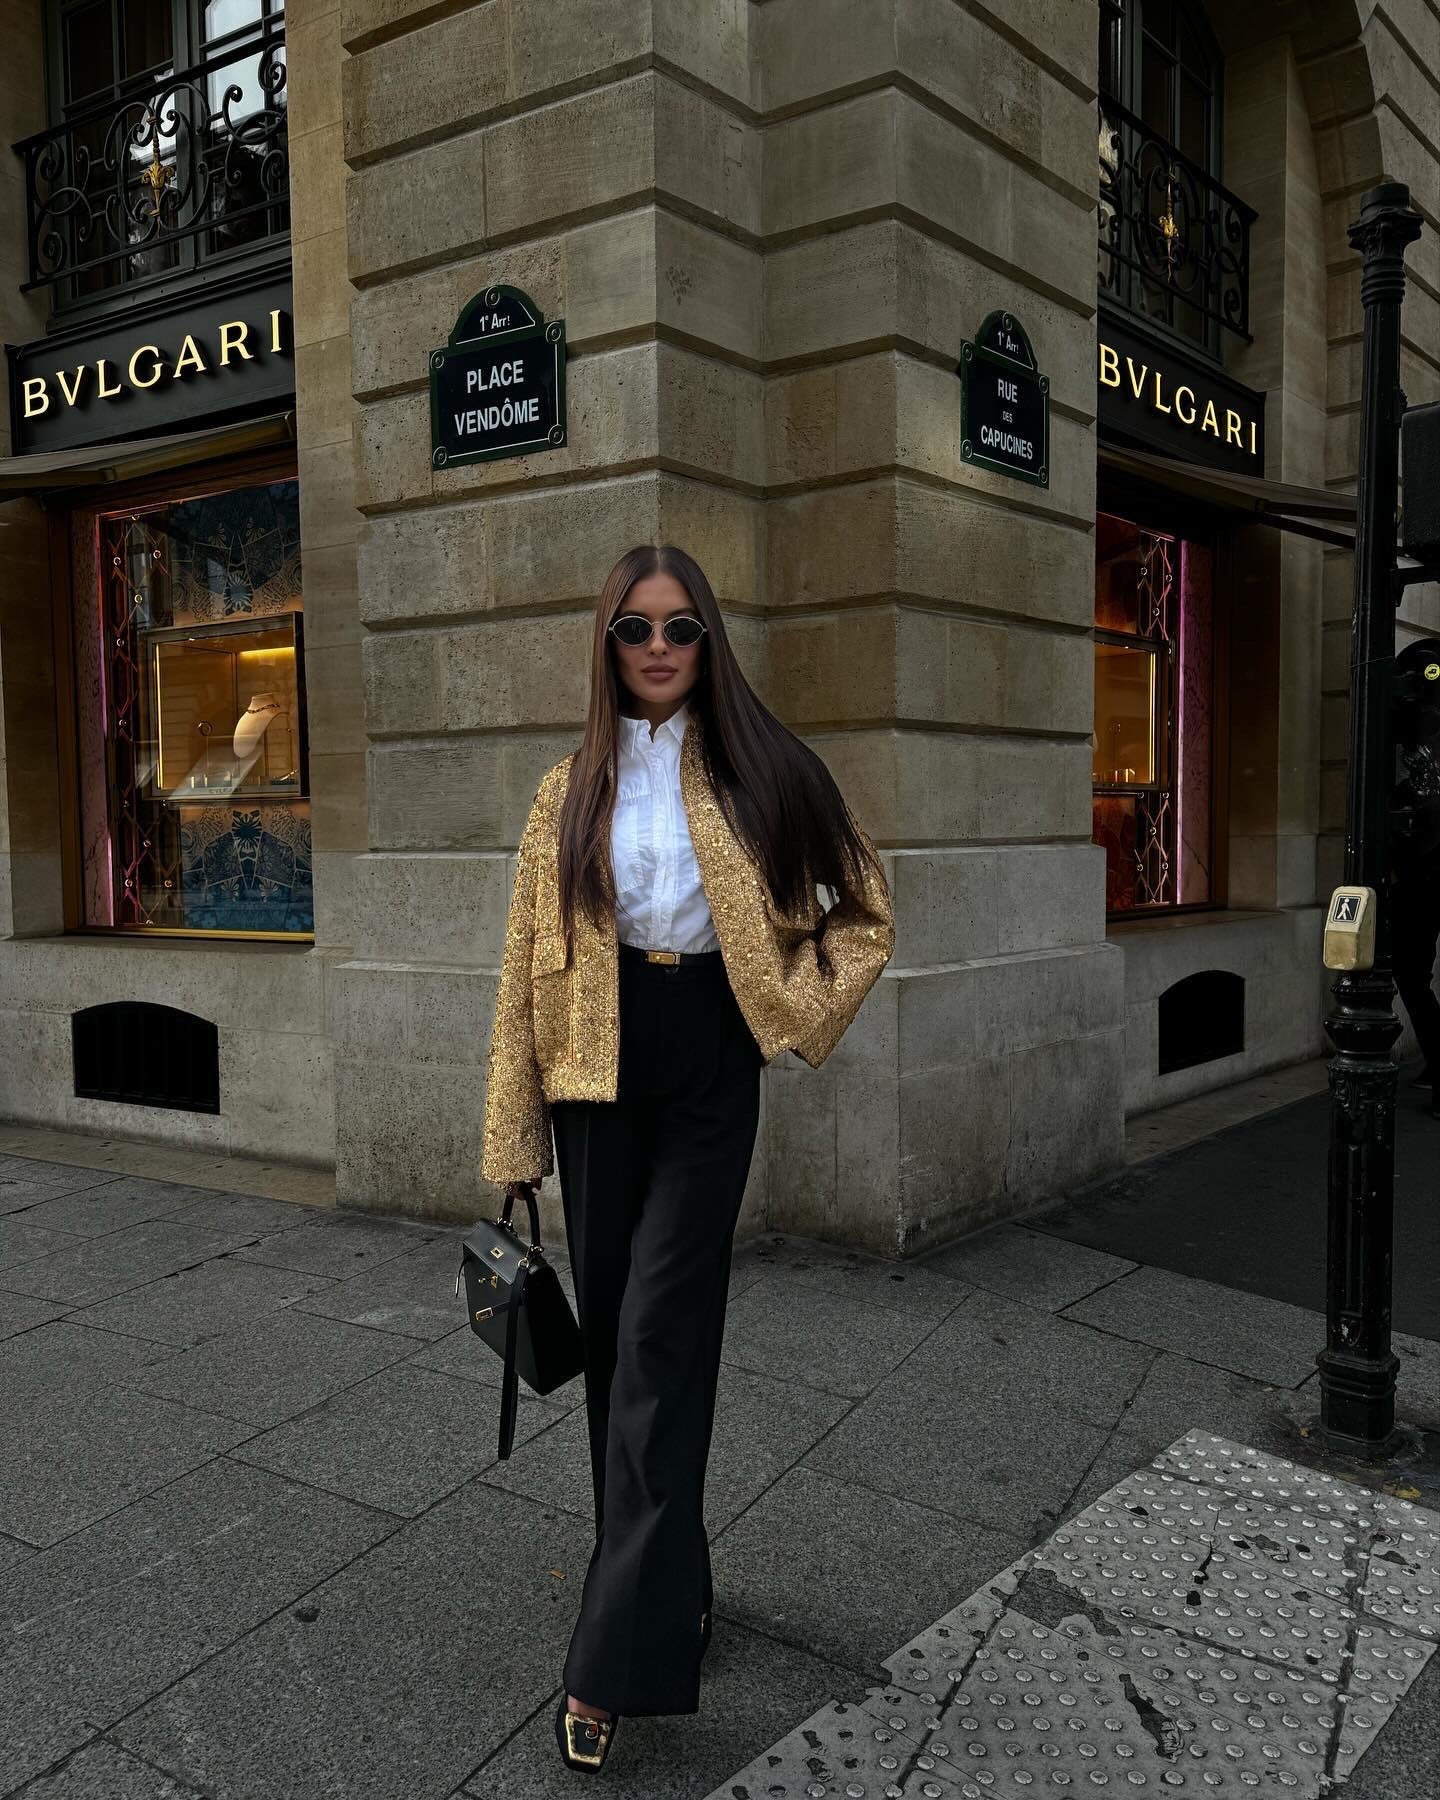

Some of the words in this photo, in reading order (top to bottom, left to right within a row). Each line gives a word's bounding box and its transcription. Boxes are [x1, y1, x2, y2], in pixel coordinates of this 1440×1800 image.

[23, 309, 283, 418] BVLGARI
[466, 359, 524, 393] PLACE
[997, 378, 1018, 404] RUE
[1099, 343, 1257, 455] BVLGARI
[454, 397, 540, 436] VENDÔME
[1002, 410, 1013, 424] DES
[980, 424, 1033, 460] CAPUCINES
